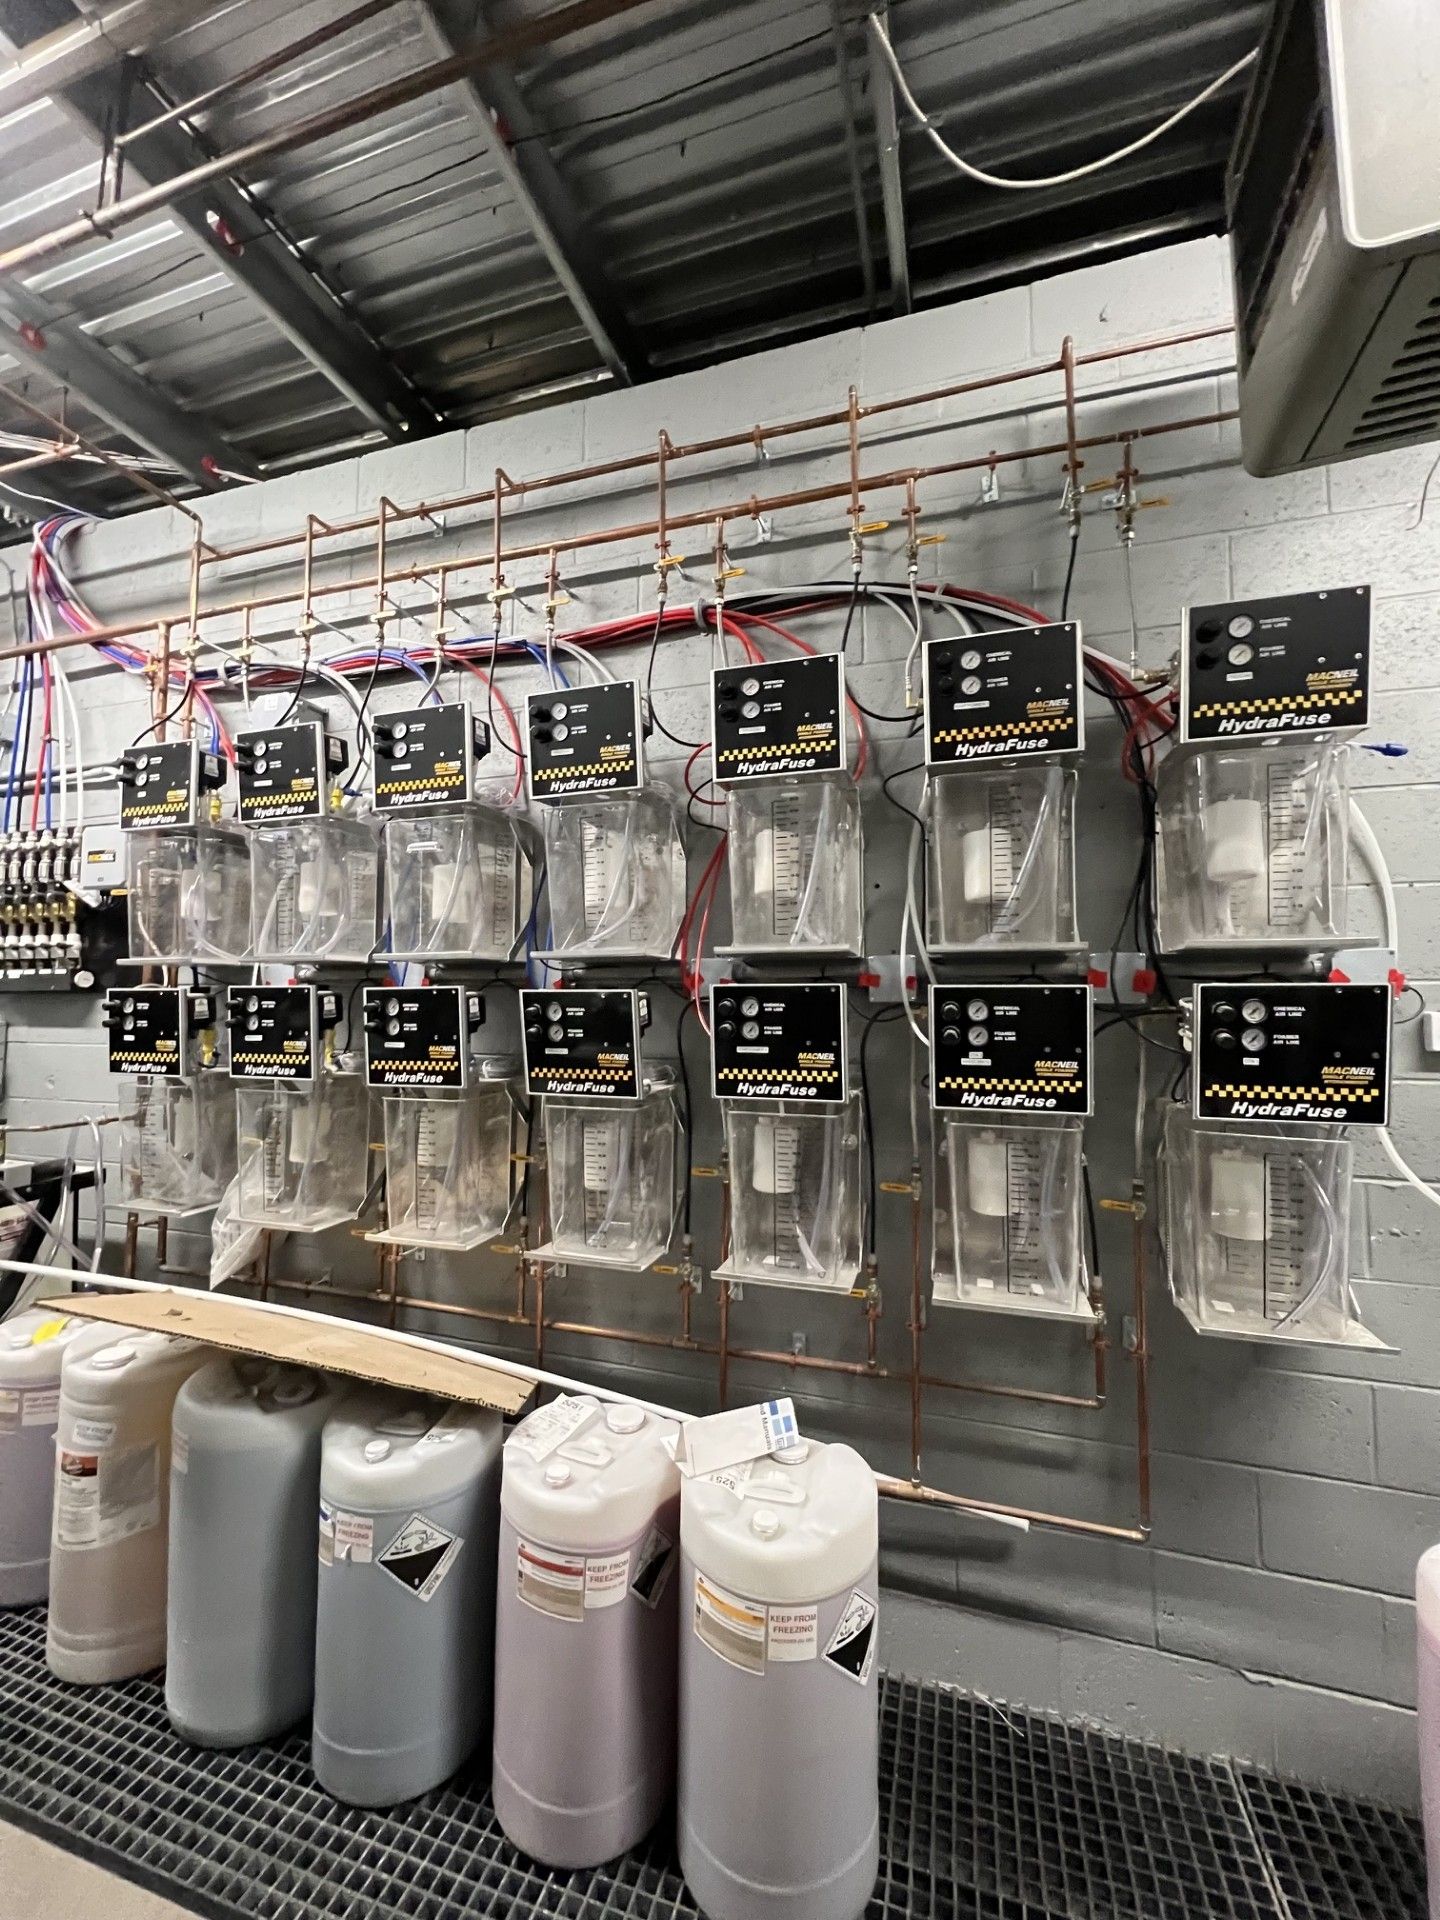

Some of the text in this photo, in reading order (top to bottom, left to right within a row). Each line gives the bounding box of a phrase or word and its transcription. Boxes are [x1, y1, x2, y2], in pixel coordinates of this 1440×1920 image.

[1305, 668, 1359, 682] MACNEIL
[1026, 698, 1071, 710] MACNEIL
[796, 722, 834, 733] MACNEIL
[1218, 713, 1332, 733] HydraFuse
[955, 738, 1049, 757] HydraFuse
[736, 758, 816, 775] HydraFuse
[549, 777, 617, 792] HydraFuse
[390, 790, 449, 805] HydraFuse
[253, 804, 305, 818] HydraFuse
[597, 1052, 630, 1061] MACNEIL
[797, 1052, 836, 1060] MACNEIL
[121, 1062, 167, 1073] HydraFuse
[244, 1064, 296, 1076] HydraFuse
[1034, 1060, 1079, 1069] MACNEIL
[1321, 1066, 1376, 1075] MACNEIL
[384, 1071, 444, 1084] HydraFuse
[546, 1080, 616, 1093] HydraFuse
[736, 1082, 817, 1096] HydraFuse
[960, 1092, 1057, 1108] HydraFuse
[1230, 1101, 1347, 1118] HydraFuse
[587, 1565, 608, 1573] KEEP
[589, 1570, 626, 1583] FREEZING
[770, 1613, 817, 1623] KEEP FROM
[773, 1625, 813, 1634] FREEZING
